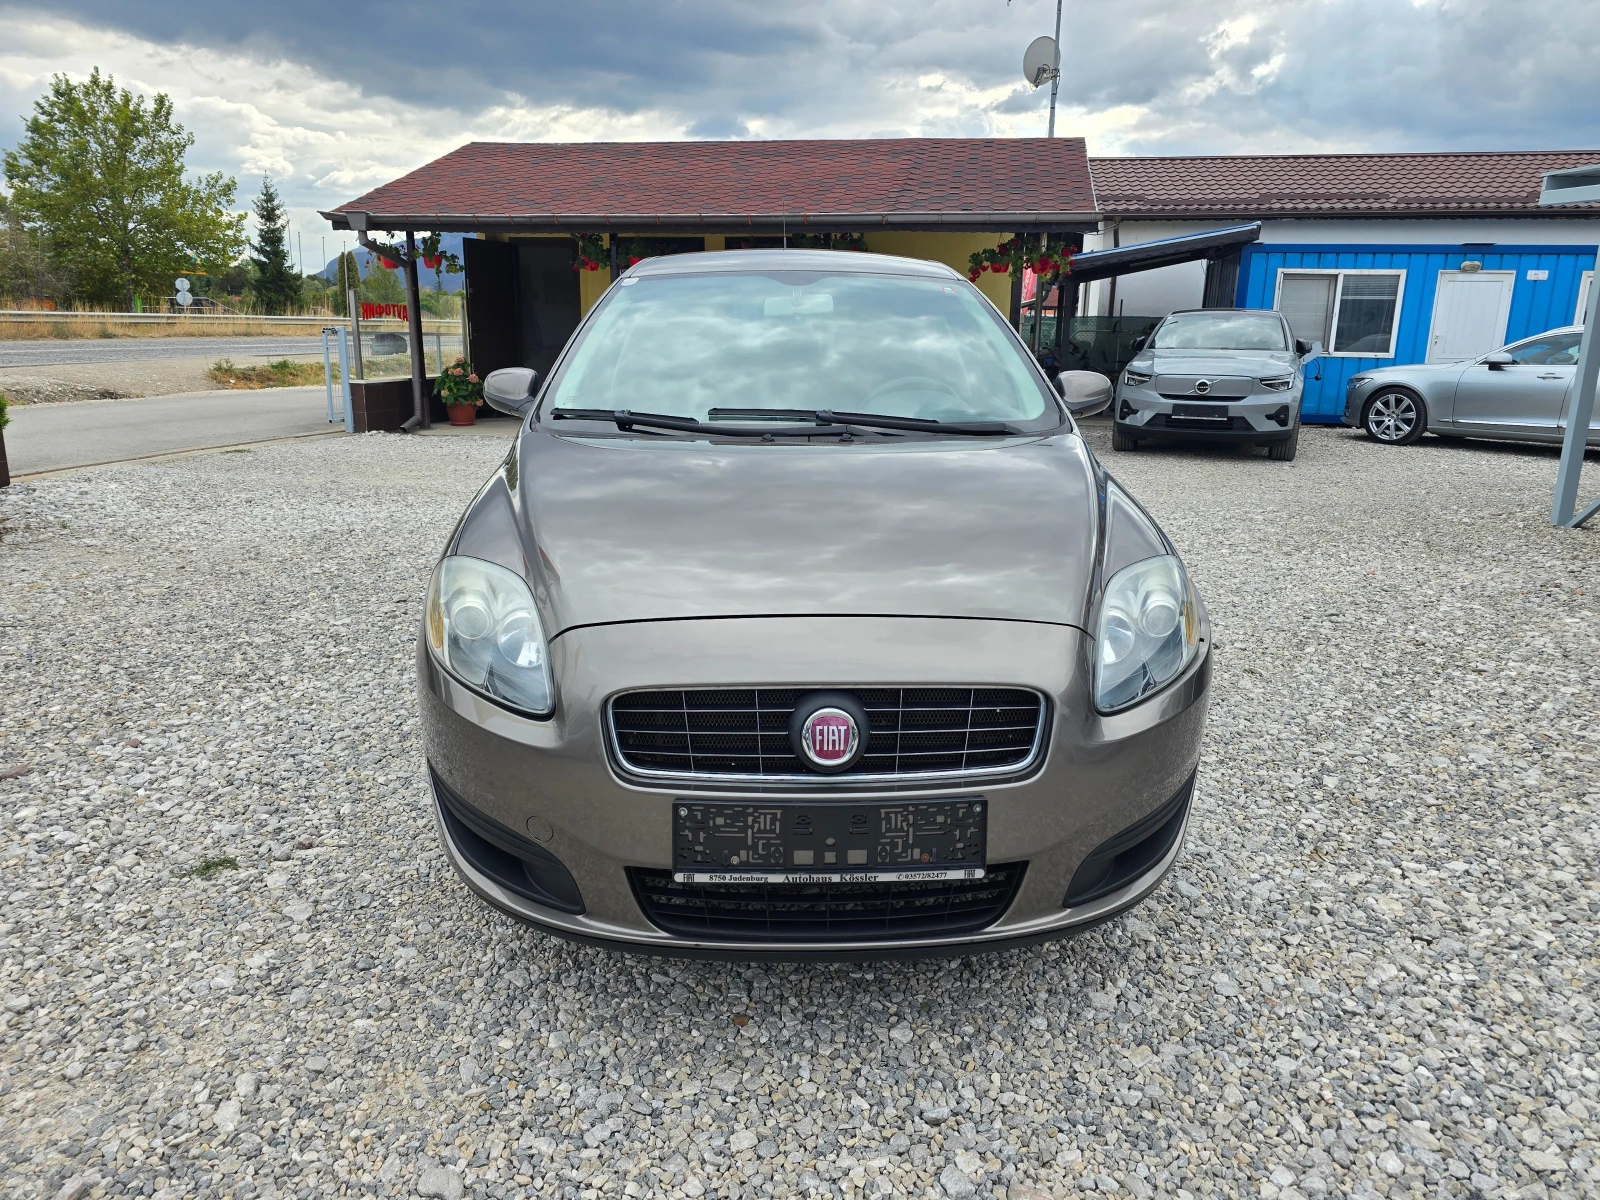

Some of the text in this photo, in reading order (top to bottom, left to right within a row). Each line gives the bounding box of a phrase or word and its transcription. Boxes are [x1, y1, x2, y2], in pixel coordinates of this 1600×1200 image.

[815, 725, 848, 751] FIAT
[683, 873, 695, 883] FIAT
[709, 871, 948, 884] 8750 Judenburg Autohaus Kössler 03572/82477
